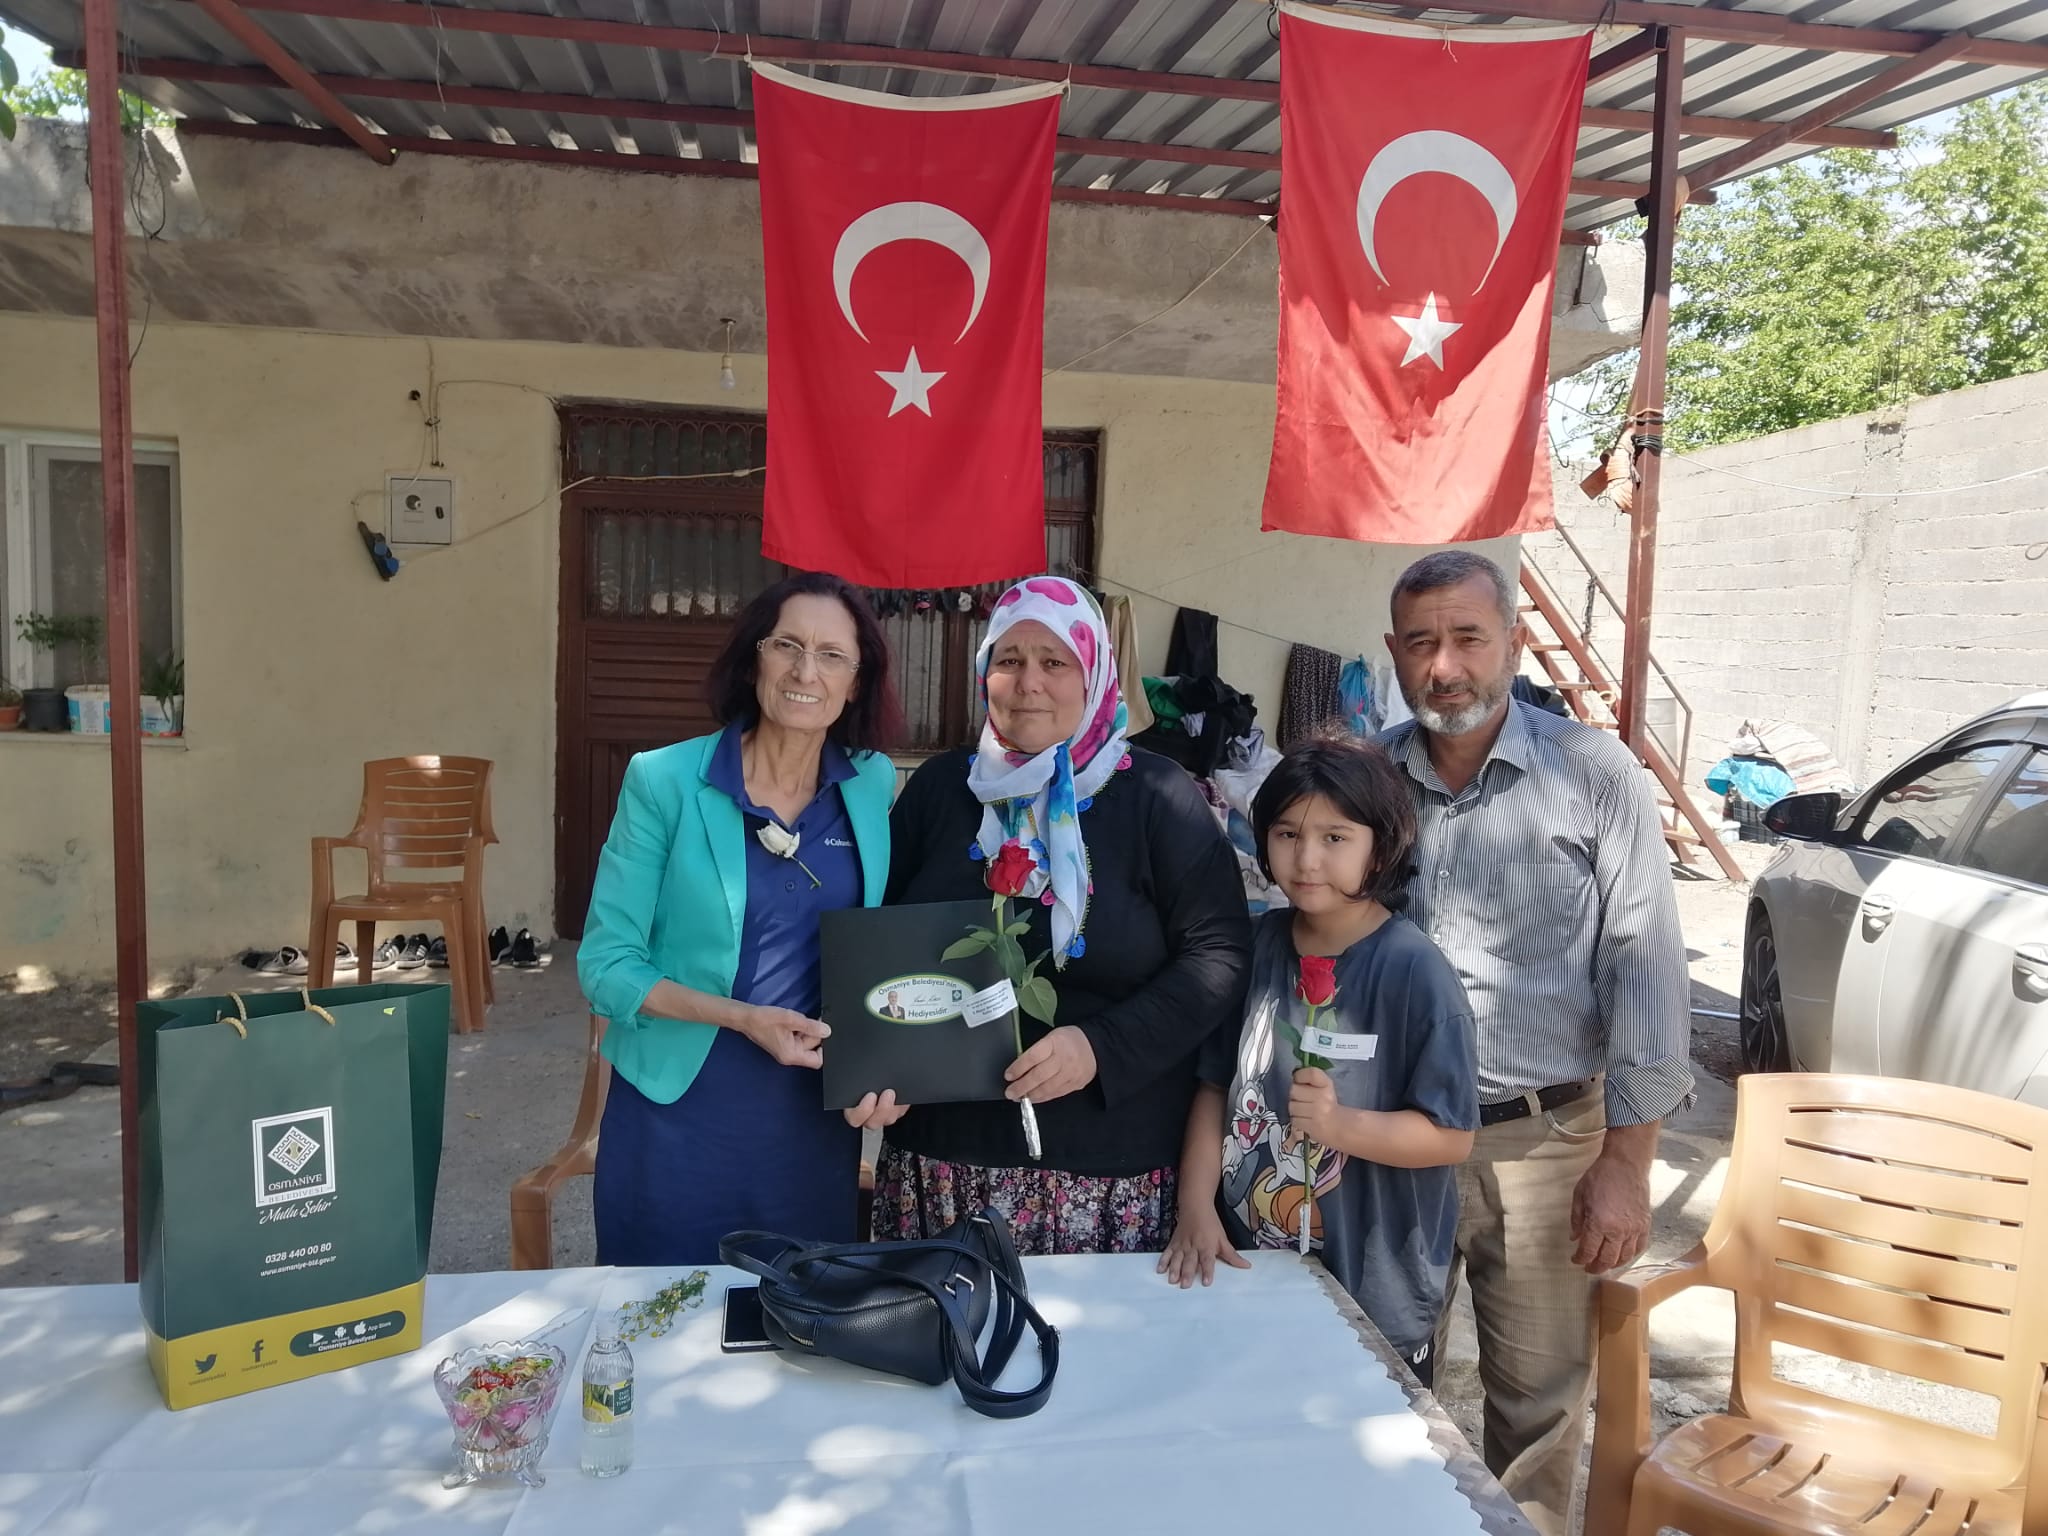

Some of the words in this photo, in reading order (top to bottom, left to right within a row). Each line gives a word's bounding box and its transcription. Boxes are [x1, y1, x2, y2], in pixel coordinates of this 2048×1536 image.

[878, 980, 910, 995] Osmaniye
[911, 978, 957, 988] Belediyesi'nin
[908, 1006, 948, 1018] Hediyesidir
[268, 1173, 322, 1191] OSMANİYE
[265, 1252, 287, 1264] 0328
[288, 1248, 306, 1259] 440
[307, 1245, 319, 1255] 00
[320, 1242, 332, 1252] 80
